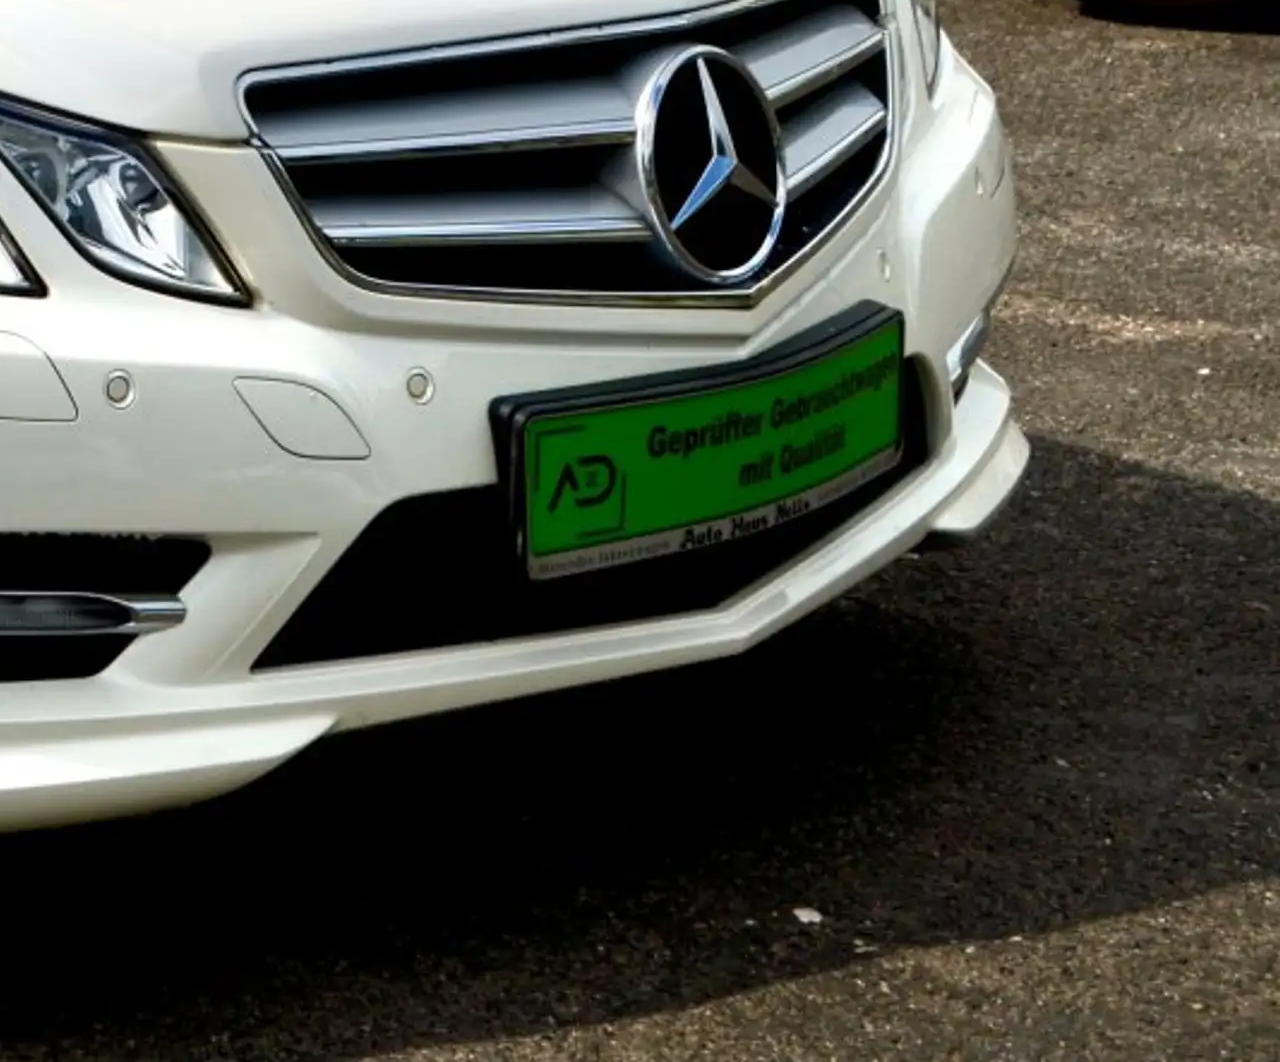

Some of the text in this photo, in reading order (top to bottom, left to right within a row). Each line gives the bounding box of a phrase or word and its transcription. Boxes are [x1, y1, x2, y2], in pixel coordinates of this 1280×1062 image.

[647, 412, 764, 462] Geprüfter
[739, 451, 774, 488] mit
[679, 525, 723, 550] Auto
